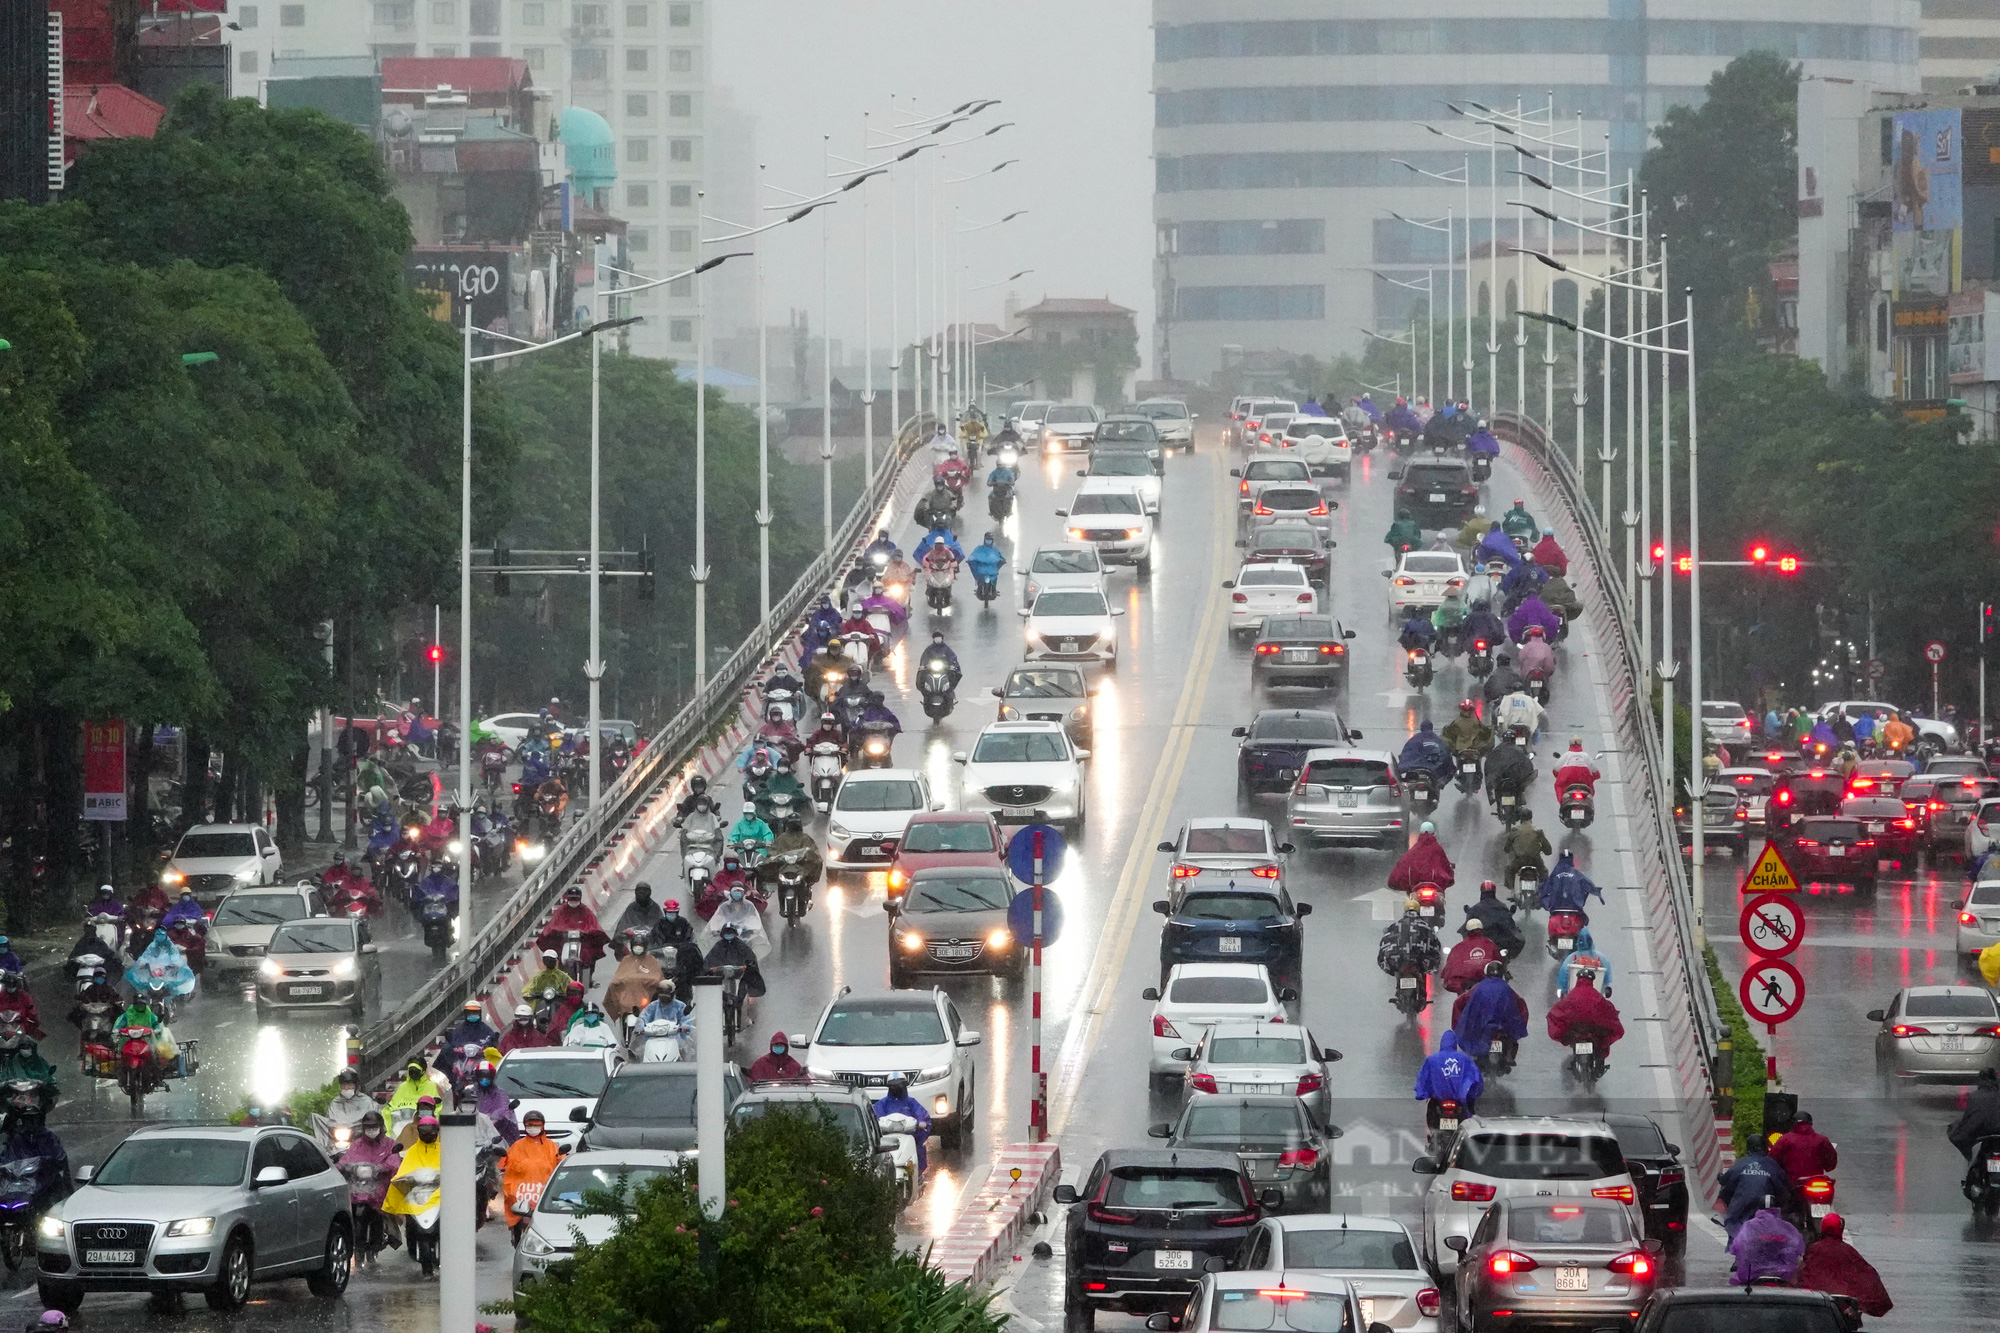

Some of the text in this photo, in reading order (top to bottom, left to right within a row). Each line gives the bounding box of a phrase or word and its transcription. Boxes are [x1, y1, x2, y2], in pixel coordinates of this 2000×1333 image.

[1764, 862, 1778, 873] ĐI
[1753, 873, 1789, 888] CHẬM
[1166, 1251, 1182, 1259] 30G
[1159, 1260, 1188, 1268] 525.49
[1563, 1268, 1581, 1278] 30A
[1556, 1279, 1587, 1289] 868.14
